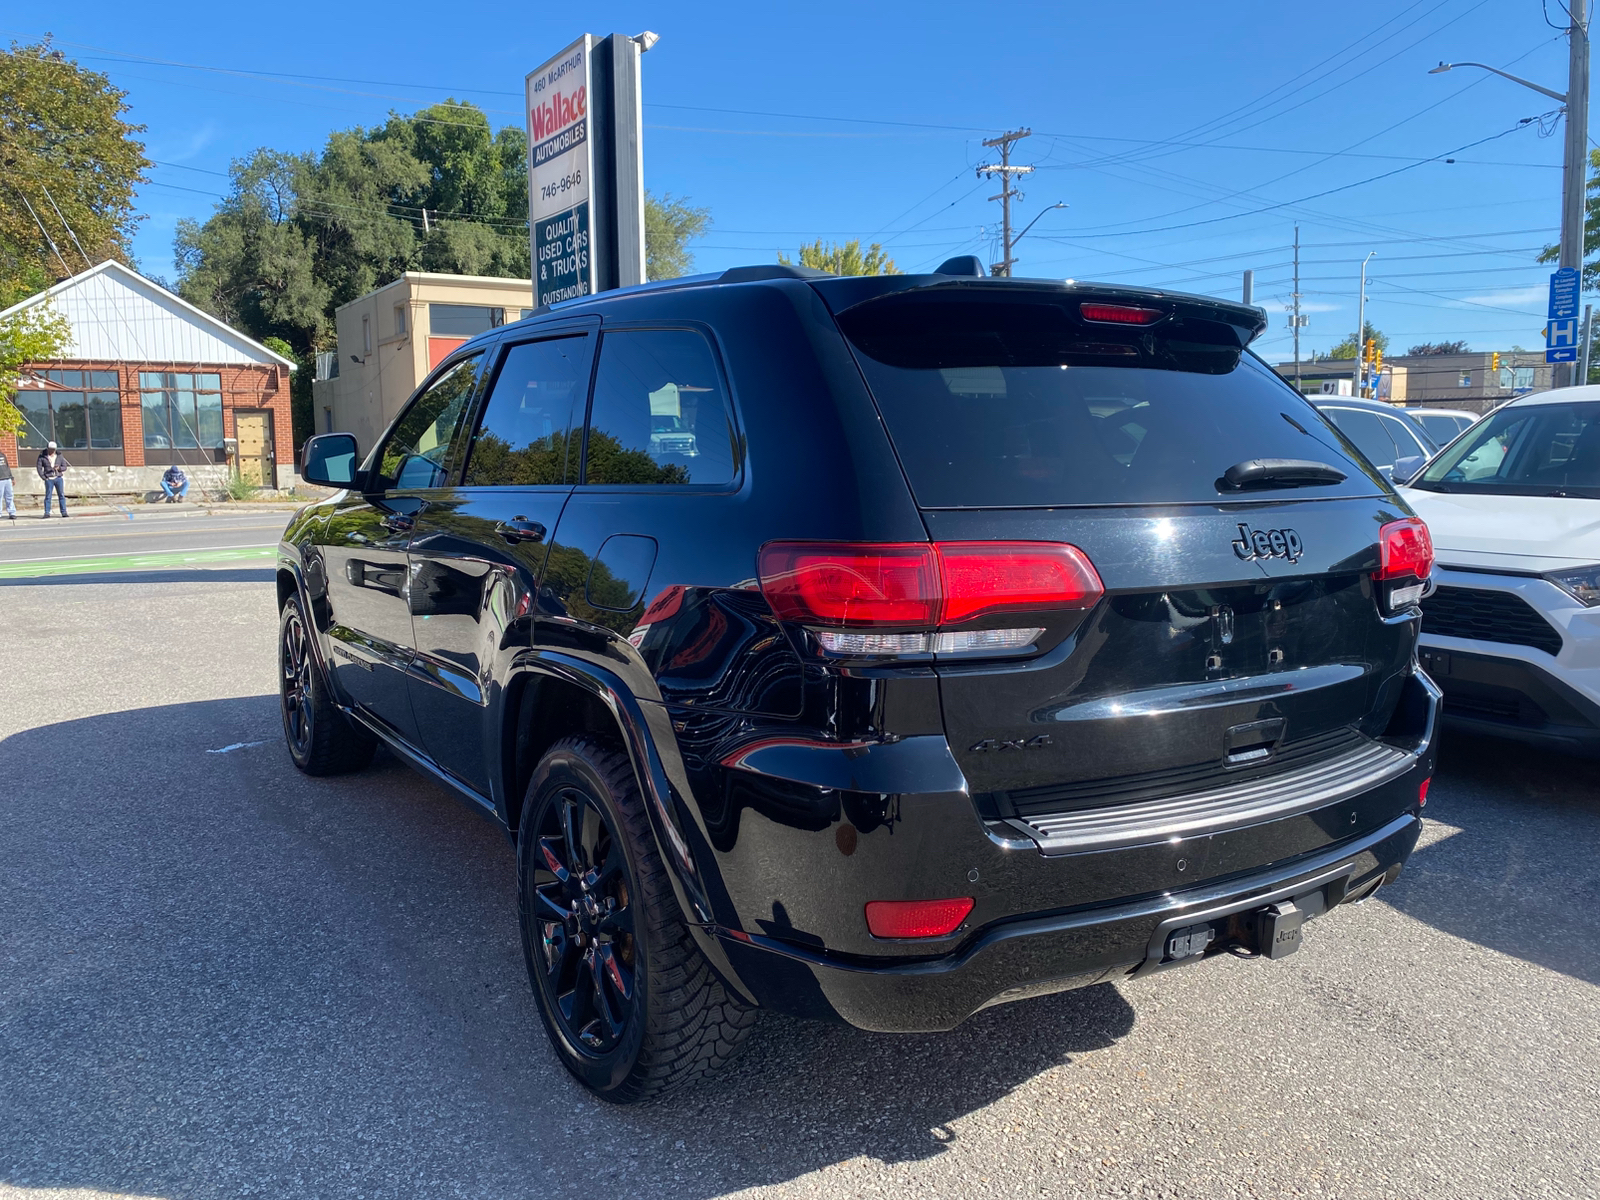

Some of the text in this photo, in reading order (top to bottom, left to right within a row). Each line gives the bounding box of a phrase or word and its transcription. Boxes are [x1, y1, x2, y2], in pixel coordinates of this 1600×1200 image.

[534, 52, 582, 93] 460 McARTHUR
[531, 85, 586, 142] Wallace
[536, 123, 585, 163] AUTOMOBILES
[541, 169, 582, 201] 746-9646
[545, 213, 580, 241] QUALITY
[539, 230, 588, 261] USED CARS
[540, 250, 588, 280] & TRUCKS
[542, 281, 588, 305] OUTSTANDING
[1551, 320, 1573, 346] H
[1231, 522, 1304, 565] Jeep
[1276, 930, 1298, 943] Jeep
